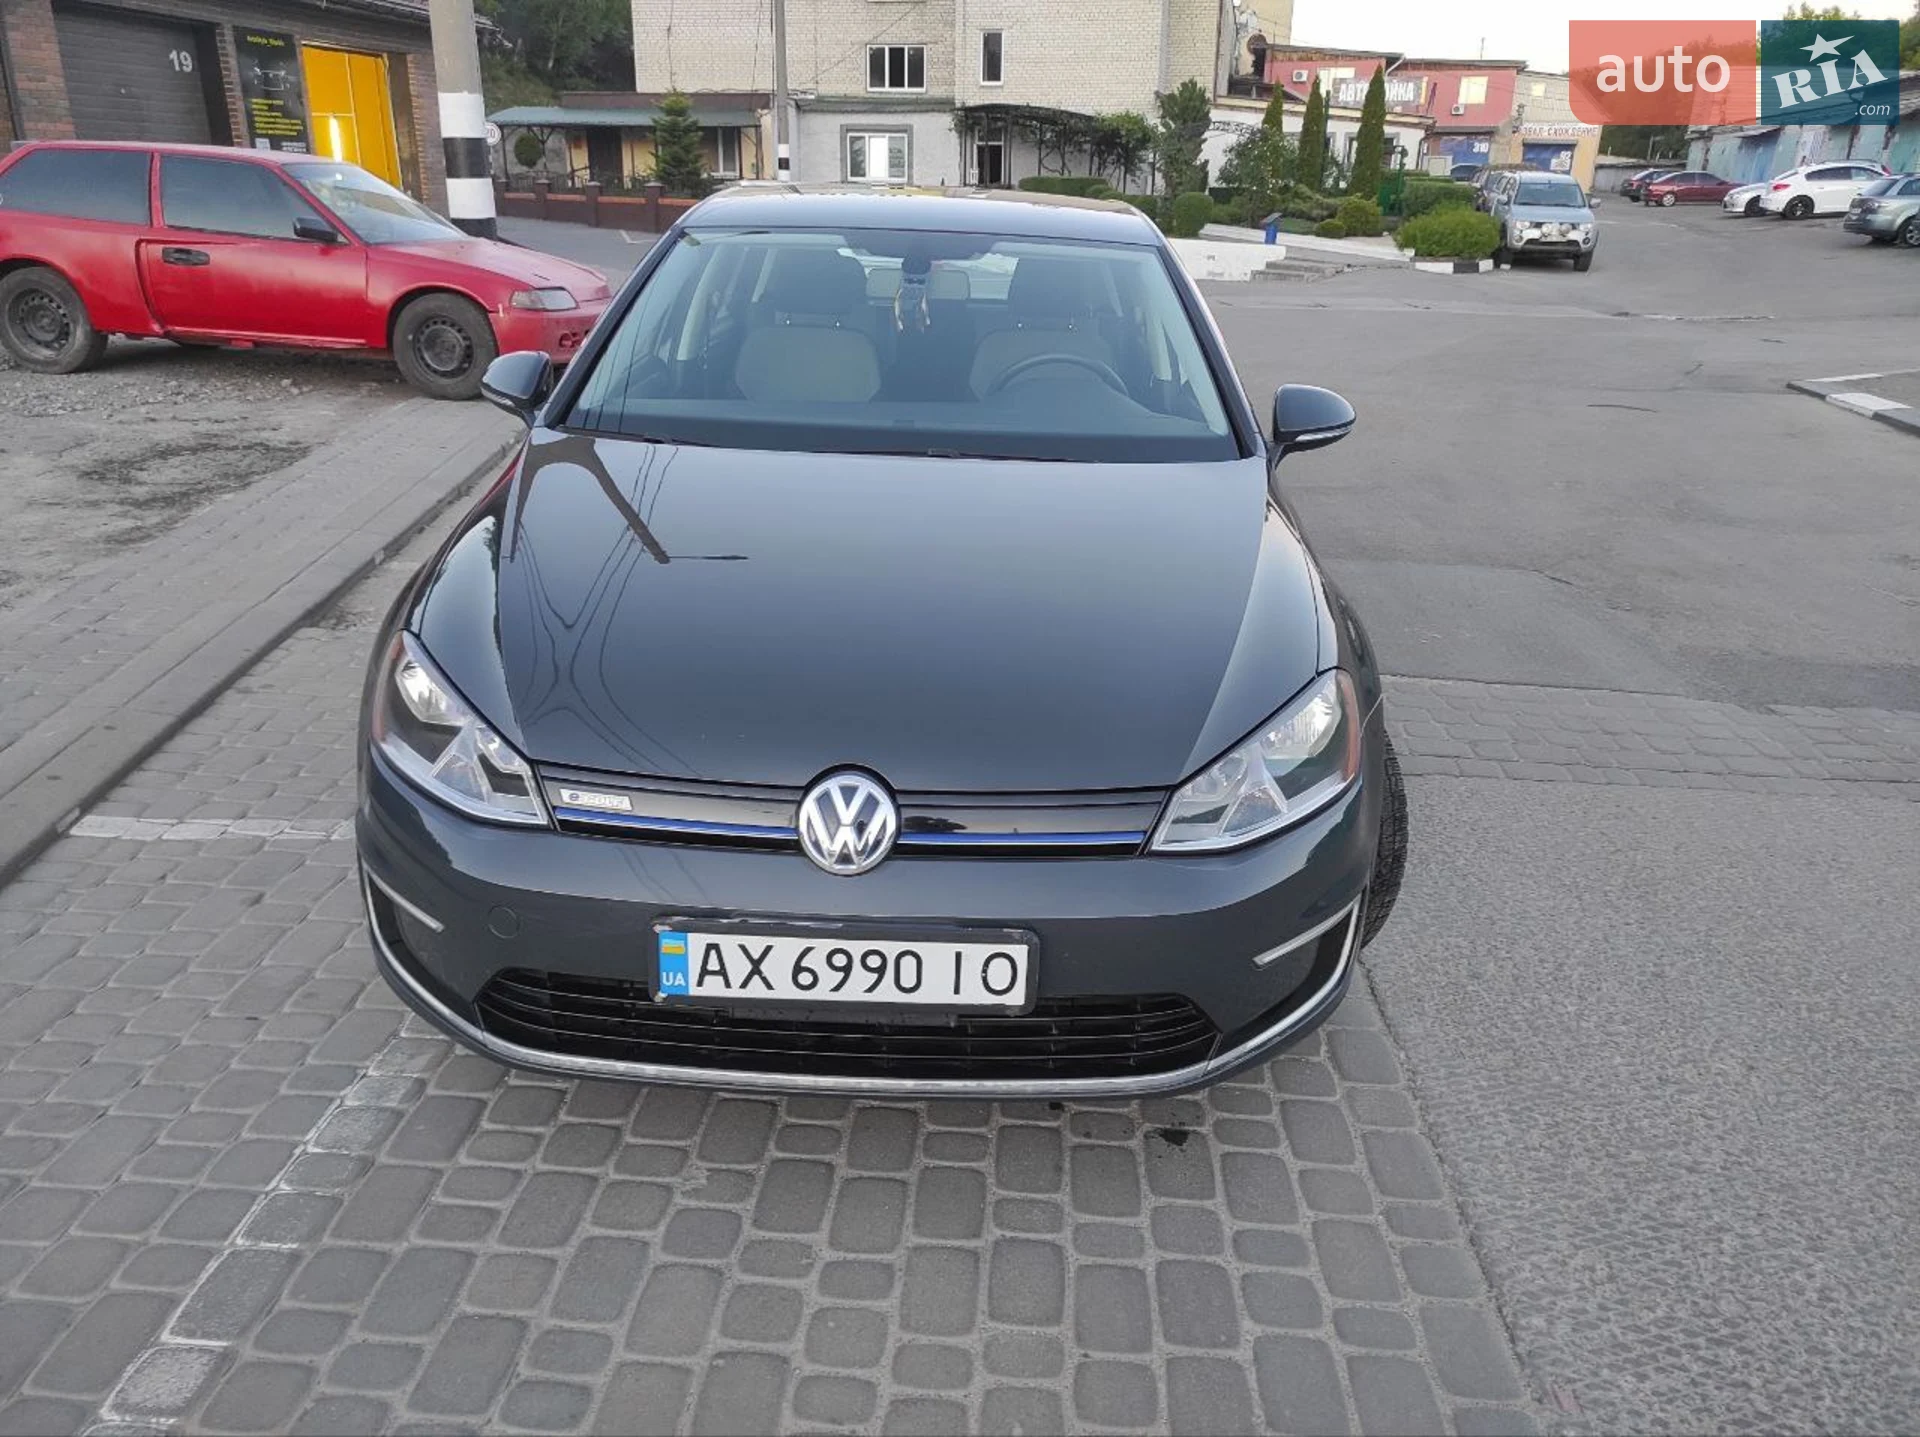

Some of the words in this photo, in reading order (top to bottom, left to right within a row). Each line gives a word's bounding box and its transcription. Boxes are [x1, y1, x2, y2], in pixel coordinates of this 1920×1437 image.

[169, 49, 193, 73] 19
[803, 778, 892, 873] VW
[662, 972, 686, 987] UA
[696, 942, 775, 991] AX
[791, 946, 923, 995] 6990
[953, 950, 1018, 997] IO
